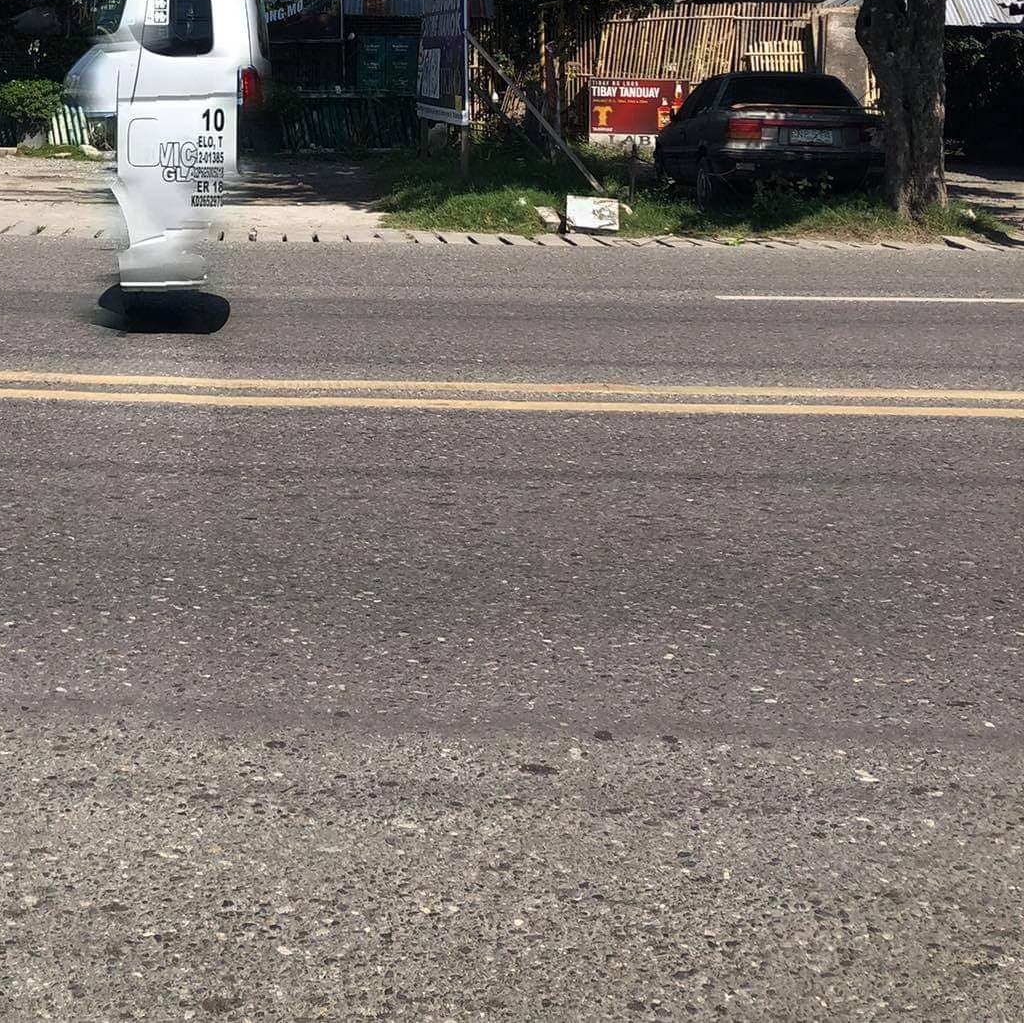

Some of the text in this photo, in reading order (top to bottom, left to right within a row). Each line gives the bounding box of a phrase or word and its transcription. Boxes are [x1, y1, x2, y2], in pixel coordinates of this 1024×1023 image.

[591, 86, 661, 98] TIBAY TANDUAY
[202, 108, 225, 132] 10
[196, 181, 210, 194] ER
